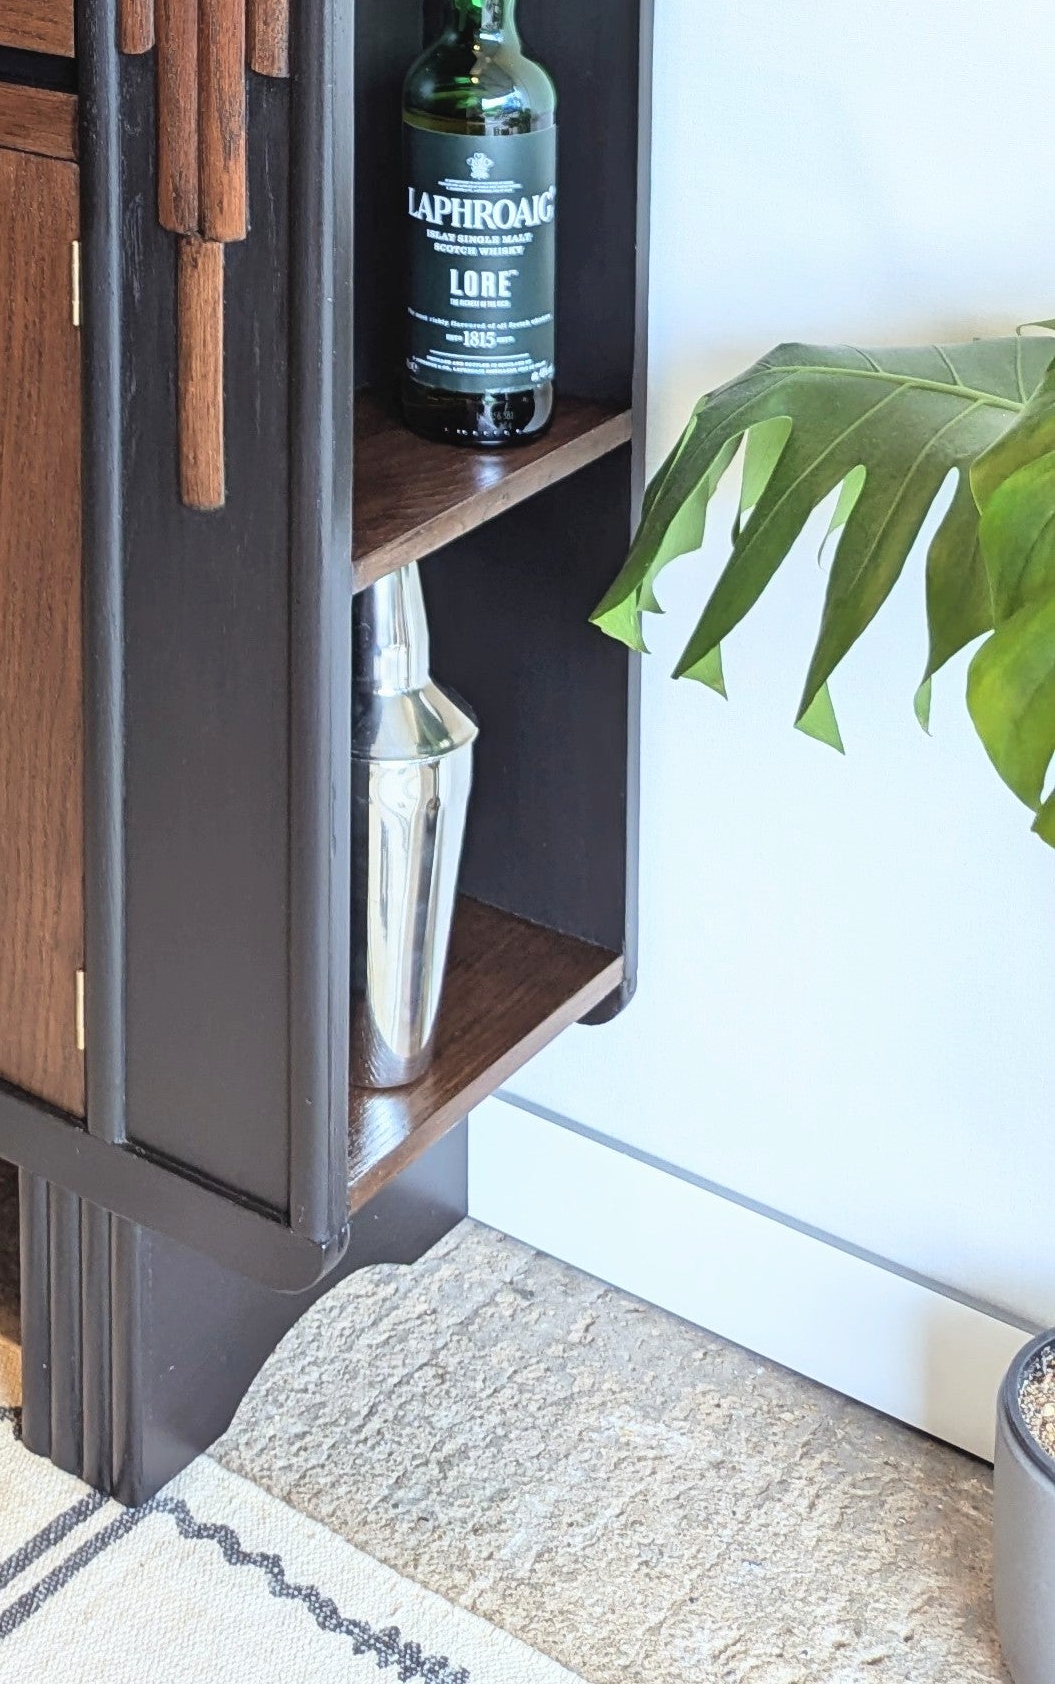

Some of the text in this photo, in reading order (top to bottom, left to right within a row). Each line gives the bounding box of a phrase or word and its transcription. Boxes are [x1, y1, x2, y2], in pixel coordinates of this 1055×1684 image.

[408, 187, 555, 230] LAPHROAIG
[426, 228, 533, 245] ISLAY SINGLE MALT
[433, 242, 525, 257] SCOTCH WHISKY
[449, 268, 512, 299] LORE
[463, 330, 498, 349] 1815
